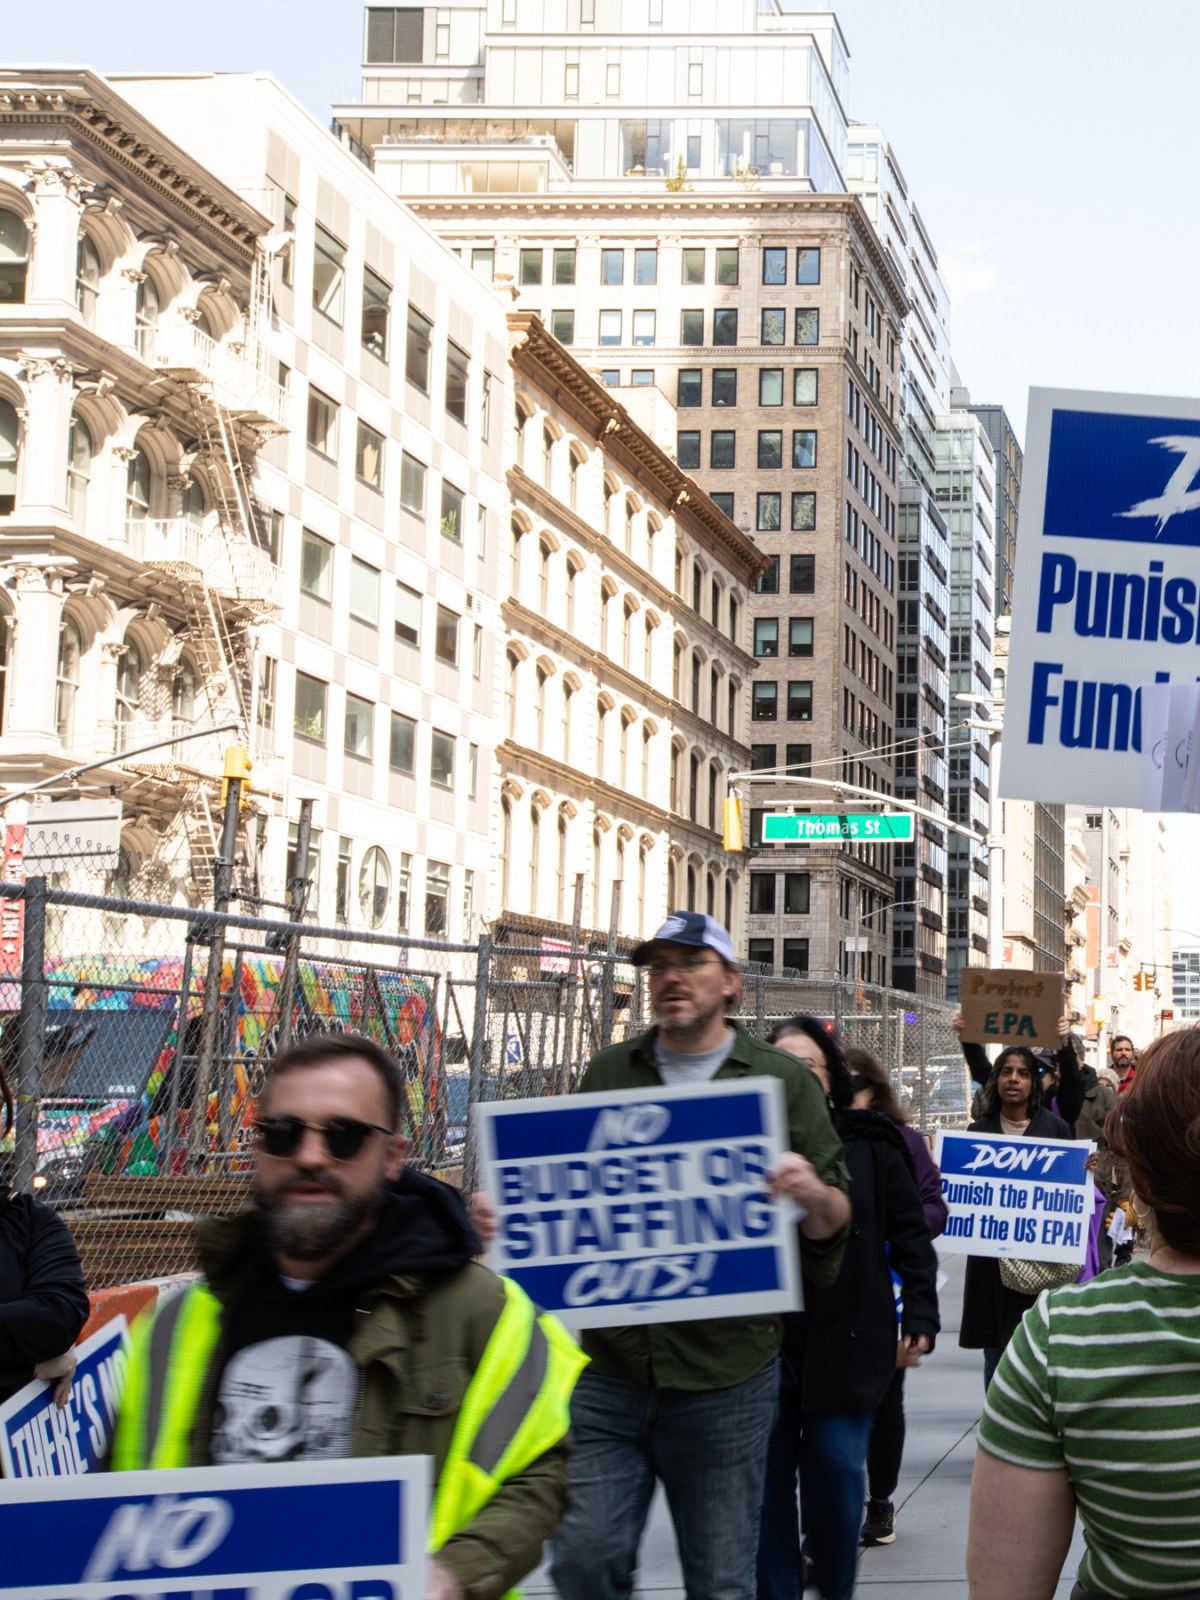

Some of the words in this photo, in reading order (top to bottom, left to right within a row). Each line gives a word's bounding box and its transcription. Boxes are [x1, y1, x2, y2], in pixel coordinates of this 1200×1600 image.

[797, 819, 858, 835] Thomas
[865, 819, 880, 835] St
[970, 975, 1045, 998] Protect
[984, 1011, 1038, 1038] EPA
[586, 1103, 672, 1150] NO
[502, 1152, 686, 1205] BUDGET
[703, 1144, 774, 1187] OR
[960, 1143, 1068, 1174] DON'T
[940, 1178, 994, 1206] Punish
[1000, 1184, 1028, 1209] the
[1032, 1186, 1084, 1214] Public
[503, 1192, 774, 1259] STAFFING
[943, 1214, 975, 1238] und
[980, 1214, 1009, 1241] the
[1014, 1217, 1037, 1243] US
[1041, 1219, 1082, 1247] EPA!
[563, 1252, 718, 1306] CUTS!
[11, 1373, 107, 1478] THERE'S
[80, 1493, 233, 1583] NO
